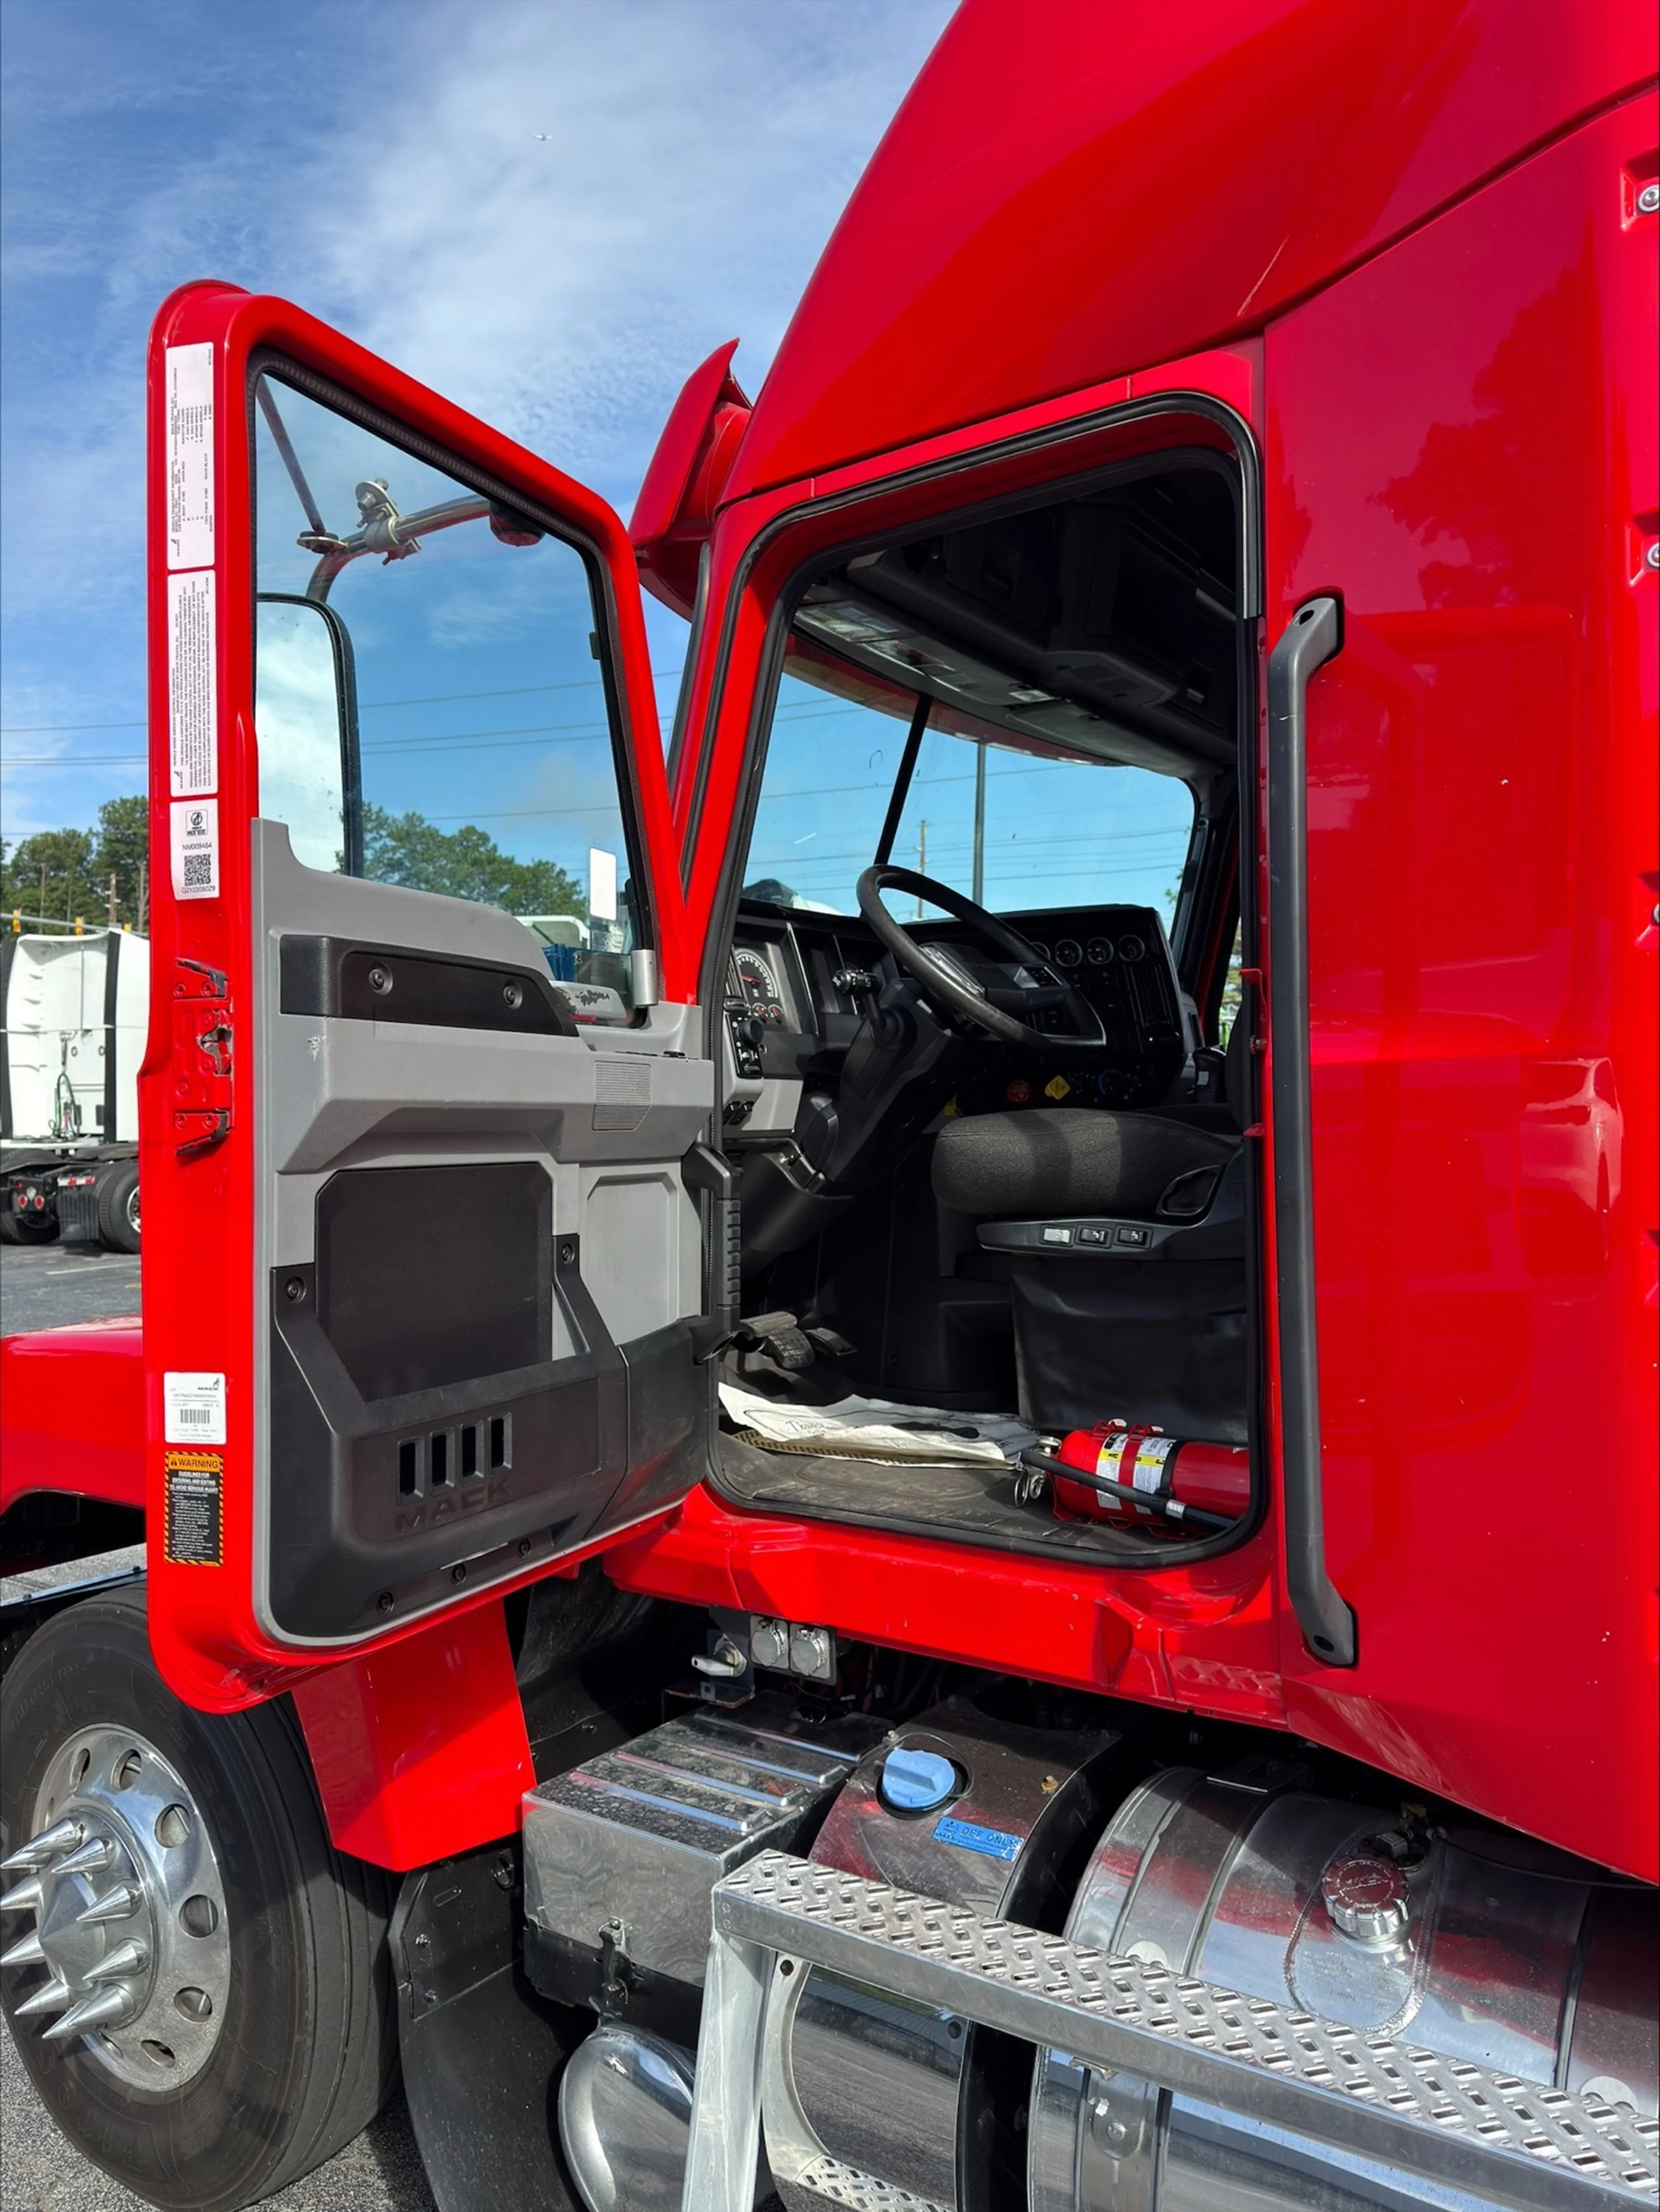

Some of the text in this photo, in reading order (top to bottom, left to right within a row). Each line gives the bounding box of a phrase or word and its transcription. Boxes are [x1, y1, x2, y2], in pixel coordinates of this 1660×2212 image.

[178, 1458, 218, 1469] WARNING
[395, 1477, 512, 1531] MACK
[962, 1826, 984, 1838] DEF
